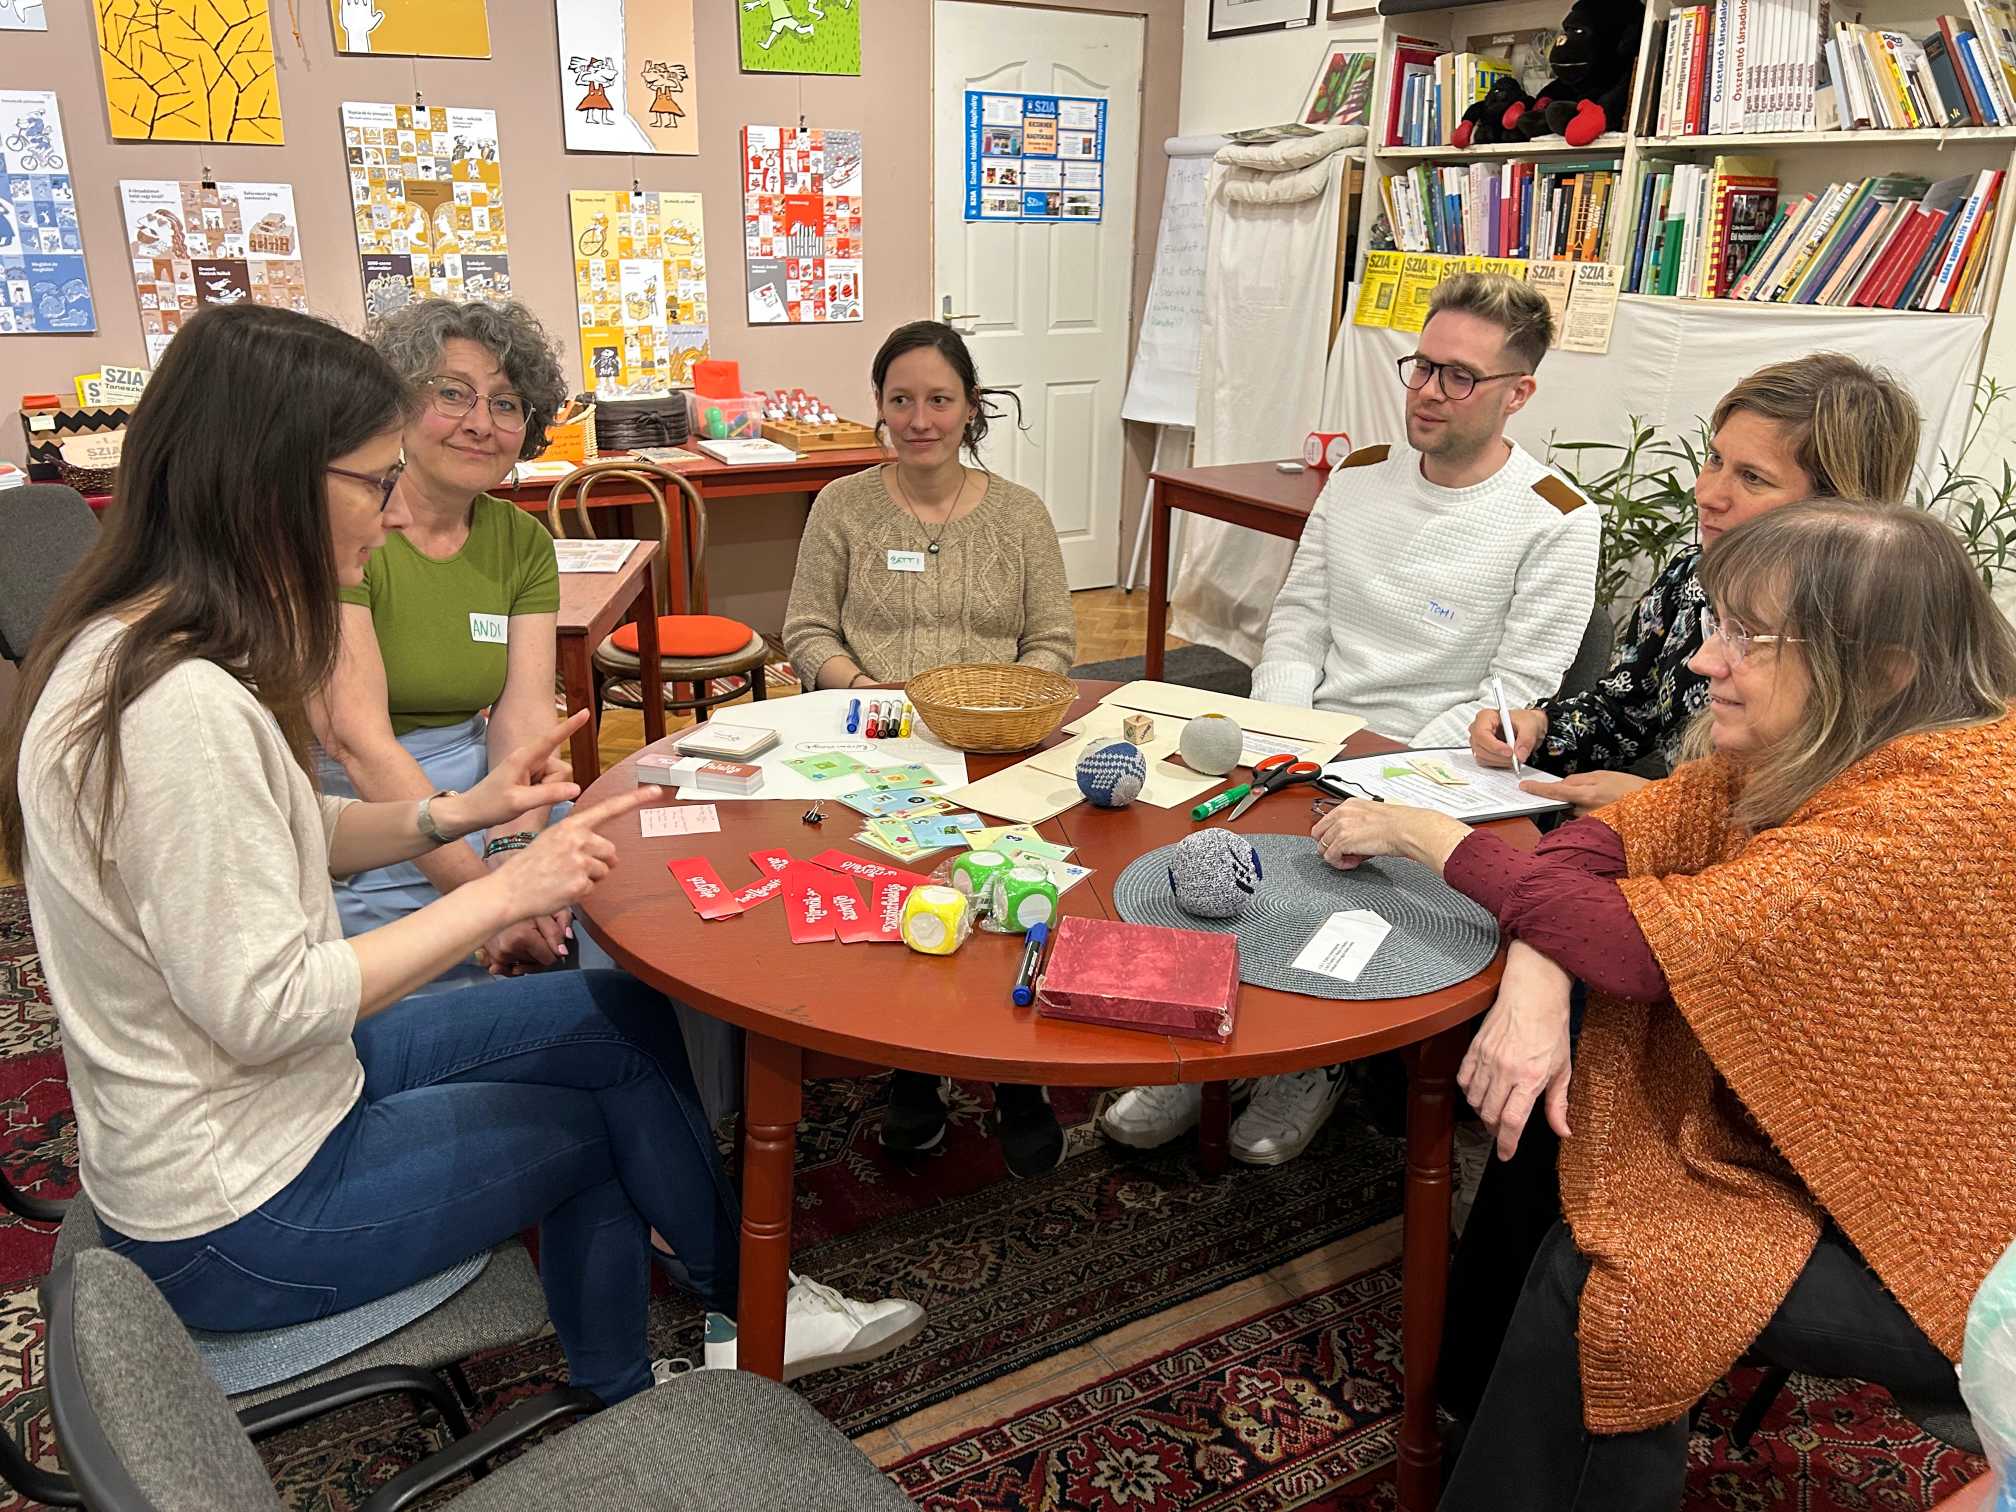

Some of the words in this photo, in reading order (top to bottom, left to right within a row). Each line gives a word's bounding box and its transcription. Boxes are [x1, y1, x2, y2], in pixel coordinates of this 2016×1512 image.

[1719, 0, 1729, 47] társadalo
[1035, 101, 1055, 113] SZIA
[1368, 254, 1391, 269] SZIA
[1405, 258, 1429, 272] SZIA
[1443, 262, 1467, 276] SZIA
[1532, 265, 1556, 280] SZIA
[1579, 265, 1605, 280] SZIA
[105, 368, 144, 386] SZIA
[105, 383, 143, 393] Taneszk
[473, 618, 501, 638] ANDI
